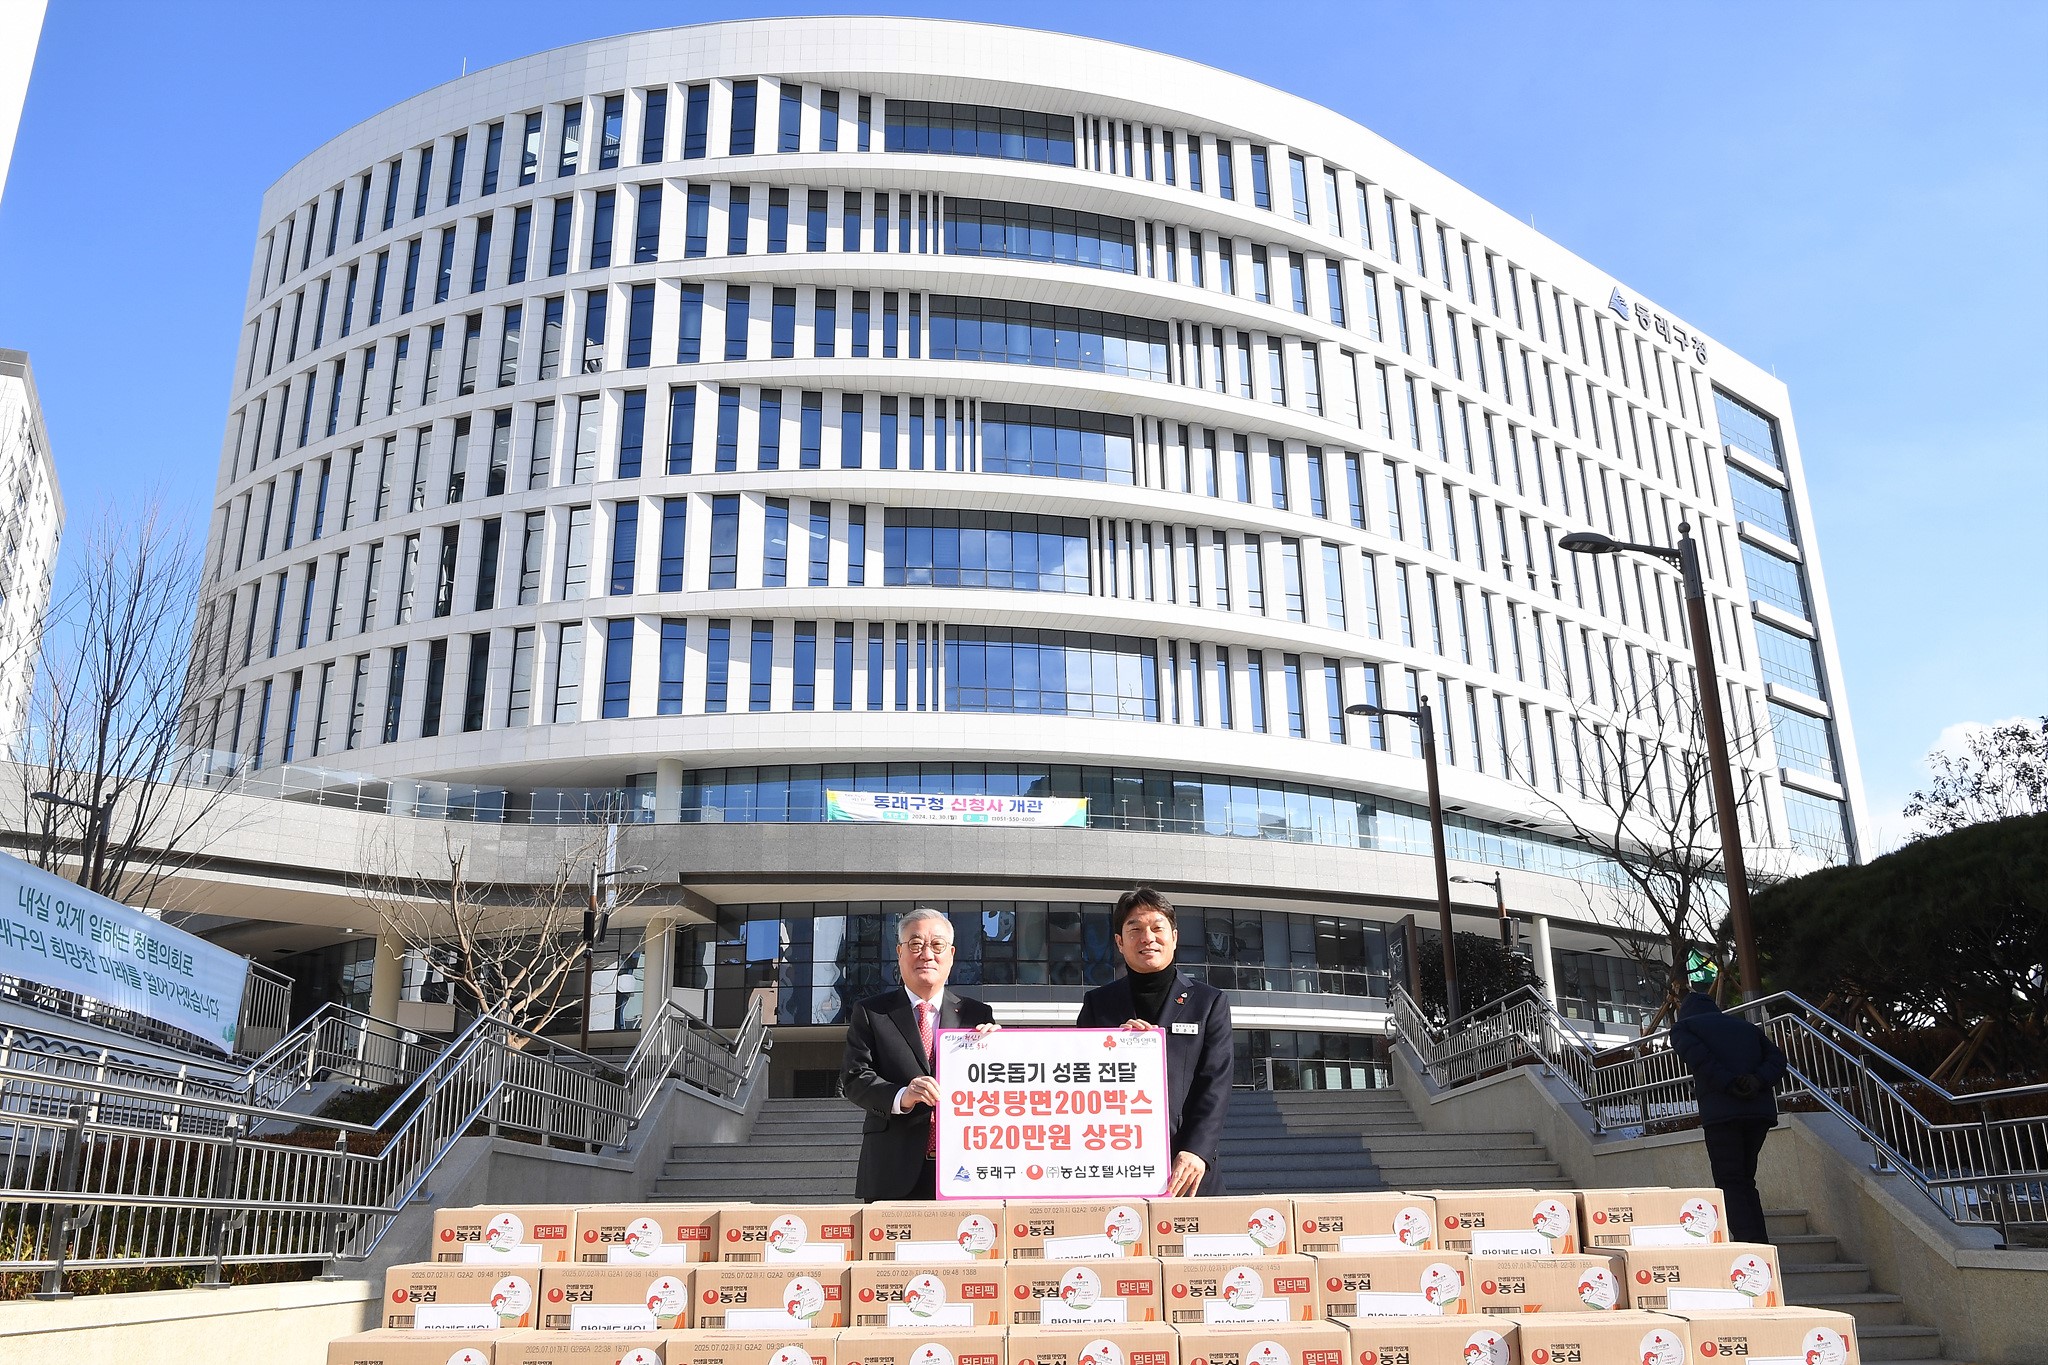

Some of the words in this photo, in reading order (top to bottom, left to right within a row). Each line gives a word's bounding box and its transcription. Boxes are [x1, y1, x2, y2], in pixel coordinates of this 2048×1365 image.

[1634, 302, 1708, 365] 동래구청
[874, 795, 944, 811] 동래구청
[951, 798, 1003, 812] 신청사
[1009, 800, 1043, 813] 개관
[19, 885, 51, 922] 내실
[55, 900, 84, 936] 있게
[90, 914, 129, 953] 일하는
[134, 931, 194, 977] 청렴의회로
[49, 936, 97, 974] 희망찬
[99, 954, 142, 991] 미래를
[143, 971, 219, 1022] 열어가겠습니다
[968, 1062, 1046, 1084] 이웃돕기
[1052, 1062, 1091, 1083] 성품
[1098, 1062, 1137, 1083] 전달
[951, 1090, 1153, 1117] 안성탕면200박스
[976, 1165, 1016, 1179] 동래구
[1460, 1218, 1485, 1229] 농심
[1608, 1212, 1633, 1223] 농심
[536, 1227, 564, 1238] 멀티팩
[823, 1227, 852, 1238] 멀티팩
[1029, 1226, 1054, 1236] 농심
[1173, 1222, 1199, 1233] 농심
[1318, 1221, 1343, 1232] 농심
[456, 1231, 481, 1242] 농심
[600, 1232, 625, 1242] 농심
[680, 1228, 708, 1238] 멀티팩
[742, 1231, 768, 1242] 농심
[886, 1230, 911, 1240] 농심
[1653, 1272, 1681, 1283] 농심
[1119, 1282, 1150, 1294] 멀티팩
[1189, 1285, 1217, 1297] 농심
[1276, 1279, 1307, 1292] 멀티팩
[1343, 1279, 1371, 1291] 농심
[1498, 1282, 1526, 1294] 농심
[409, 1291, 436, 1303] 농심
[565, 1290, 593, 1302] 농심
[720, 1292, 747, 1303] 농심
[876, 1290, 903, 1302] 농심
[964, 1286, 994, 1297] 멀티팩
[1032, 1287, 1059, 1299] 농심
[745, 1343, 762, 1351] G2A2
[1718, 1343, 1749, 1356] 농심
[1134, 1354, 1166, 1365] 멀티팩
[1306, 1352, 1339, 1365] 멀티팩
[1379, 1353, 1409, 1365] 농심
[1551, 1350, 1581, 1363] 농심
